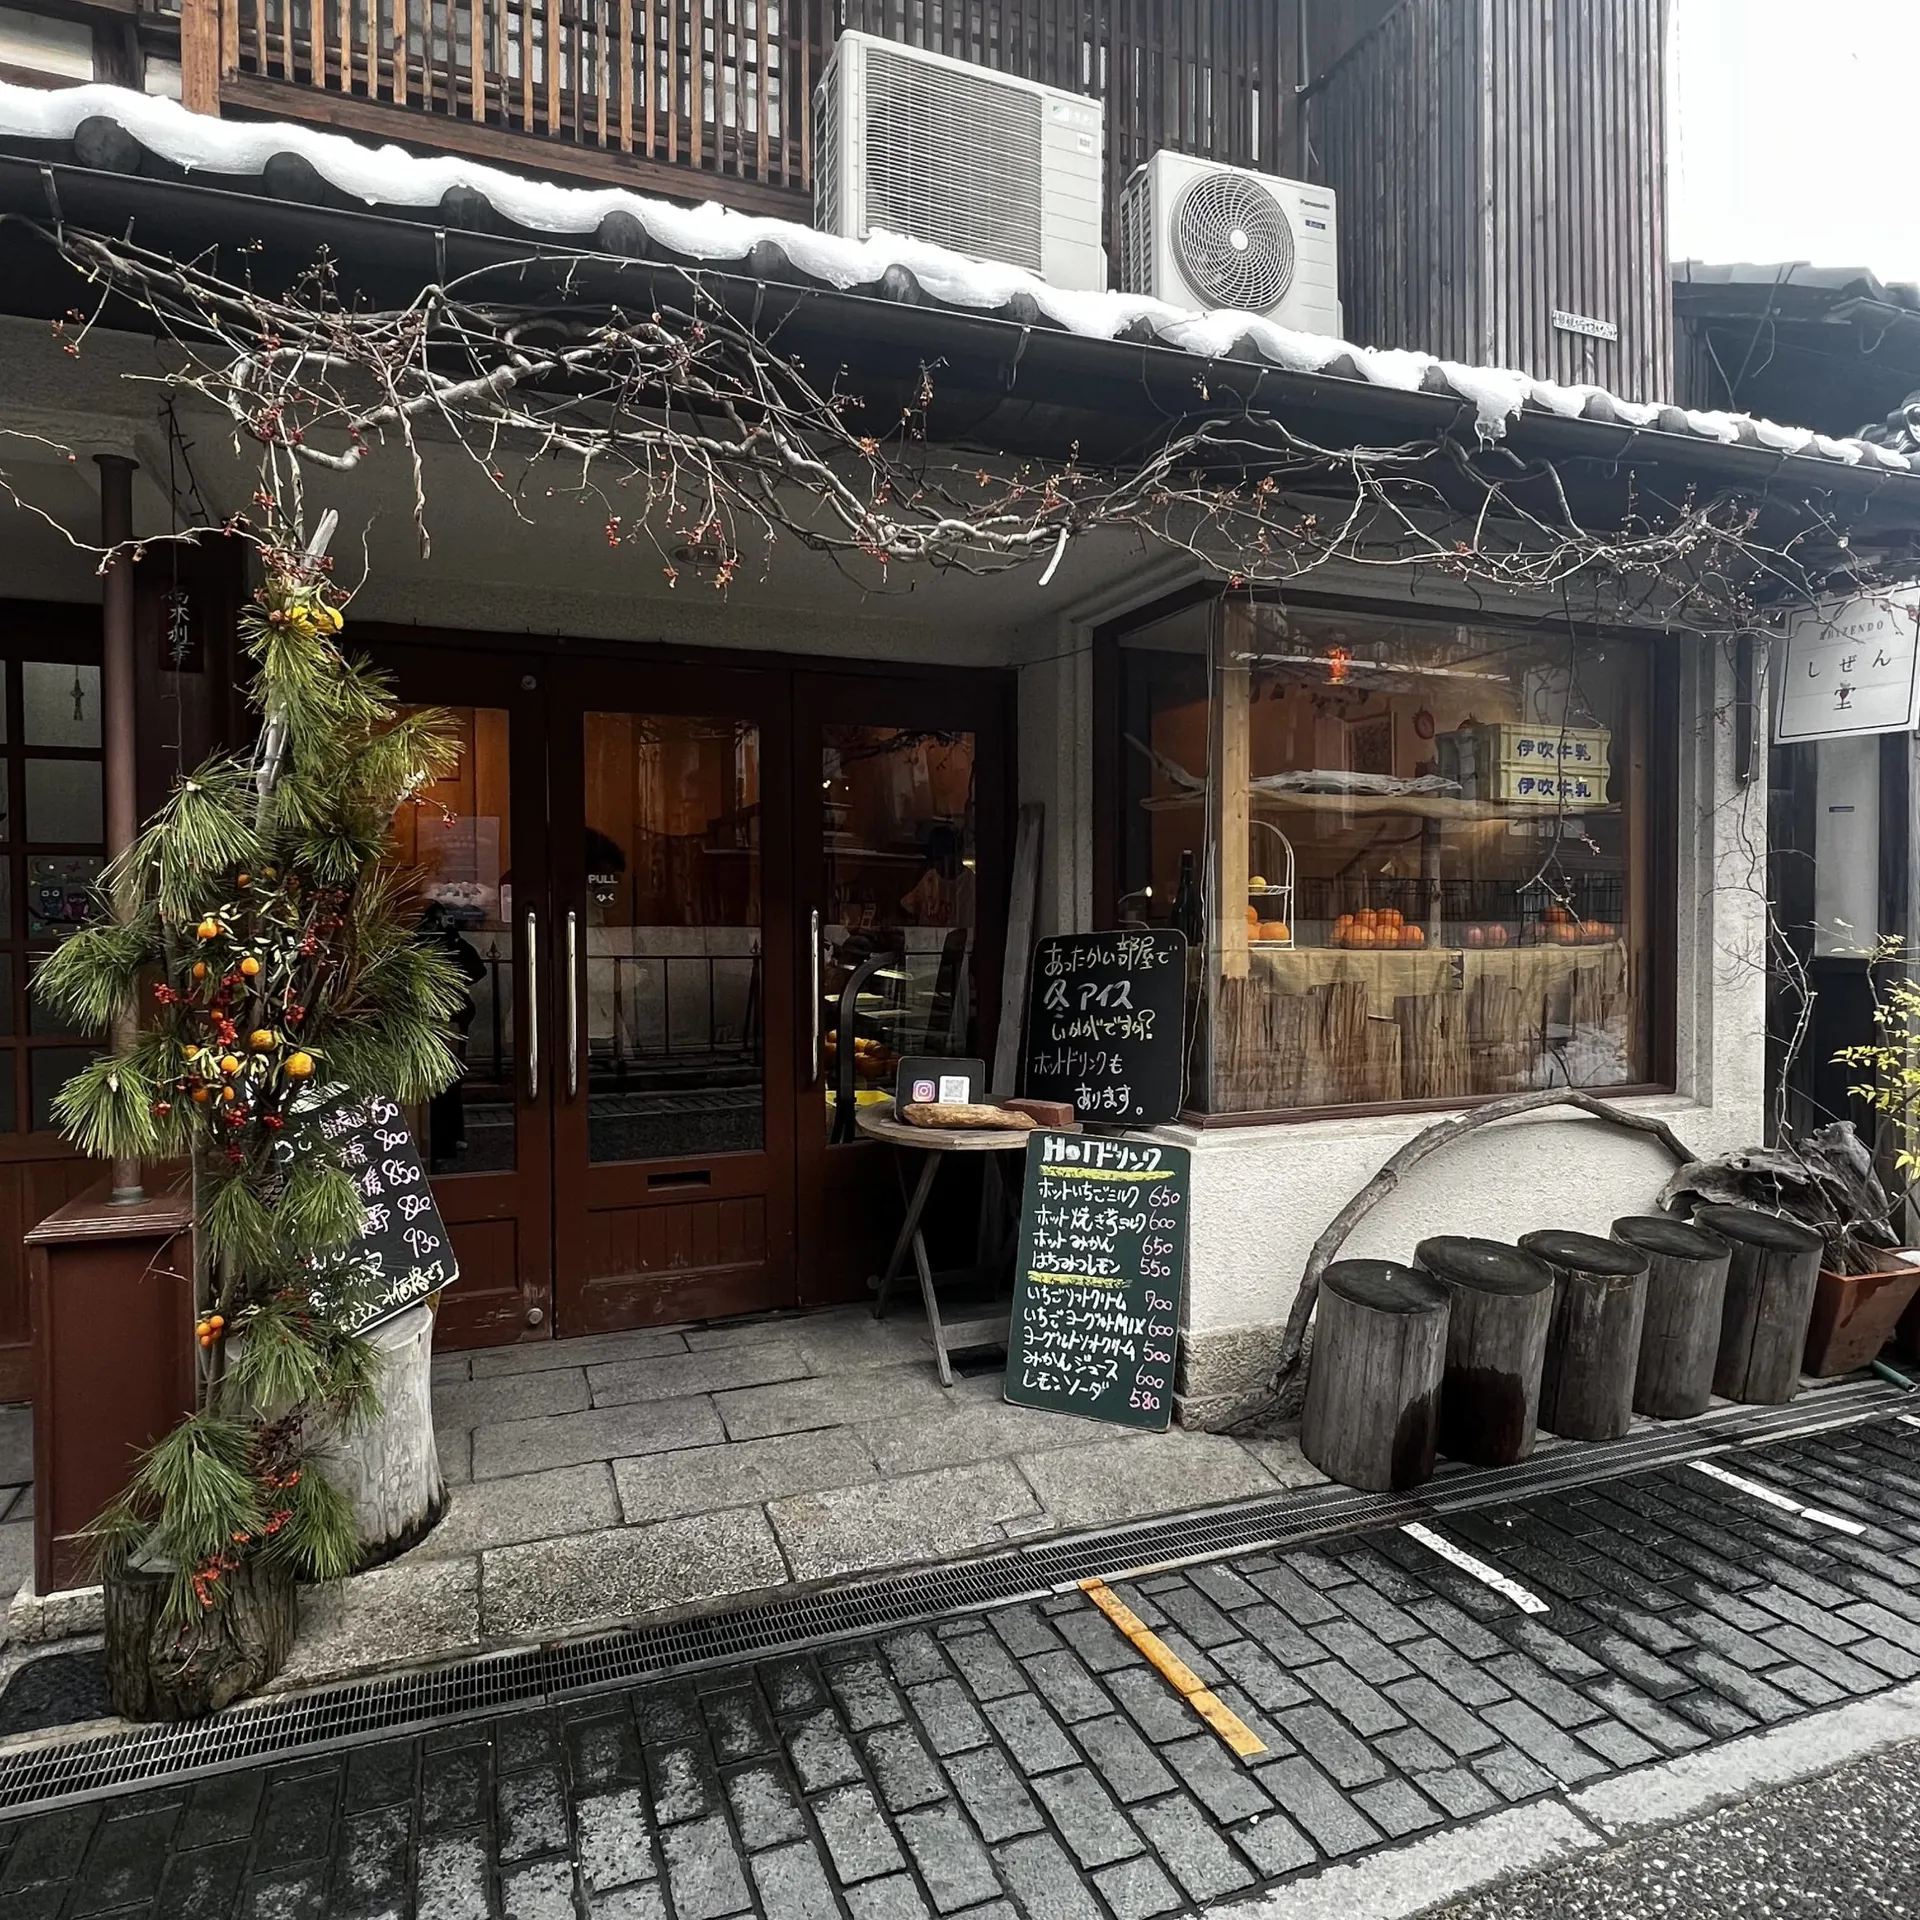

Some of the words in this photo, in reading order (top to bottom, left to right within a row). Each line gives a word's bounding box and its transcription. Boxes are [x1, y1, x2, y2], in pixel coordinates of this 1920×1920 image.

[1808, 648, 1892, 678] しぜん
[1516, 739, 1592, 762] 伊吹牛乳
[1517, 776, 1592, 798] 伊吹牛乳
[588, 874, 619, 884] PULL
[1043, 932, 1178, 976] あったかい部屋で
[1034, 1046, 1123, 1077] ホットドリンクも
[1074, 1081, 1144, 1116] あります。
[373, 1128, 409, 1152] 800
[381, 1158, 420, 1186] 850
[1038, 1177, 1140, 1209] ホットいちごミルク
[1148, 1184, 1181, 1207] 650
[396, 1194, 432, 1221] 820
[1149, 1210, 1177, 1231] 600
[403, 1227, 440, 1259] 930
[1032, 1228, 1115, 1254] ホットみかん
[1142, 1234, 1174, 1256] 650
[1032, 1250, 1121, 1276] はちみつレモン
[1139, 1258, 1171, 1278] 550
[1026, 1285, 1127, 1311] いちごソフトクリーム
[1144, 1290, 1173, 1312] 700
[1148, 1314, 1174, 1338] 600
[1023, 1325, 1136, 1362] ヨーグルトソフトクリーム
[1142, 1340, 1171, 1363] 500
[1022, 1350, 1119, 1381] みかんジュース
[1135, 1363, 1165, 1389] 600
[1022, 1369, 1110, 1401] レモンソーダ
[1129, 1387, 1161, 1410] 580
